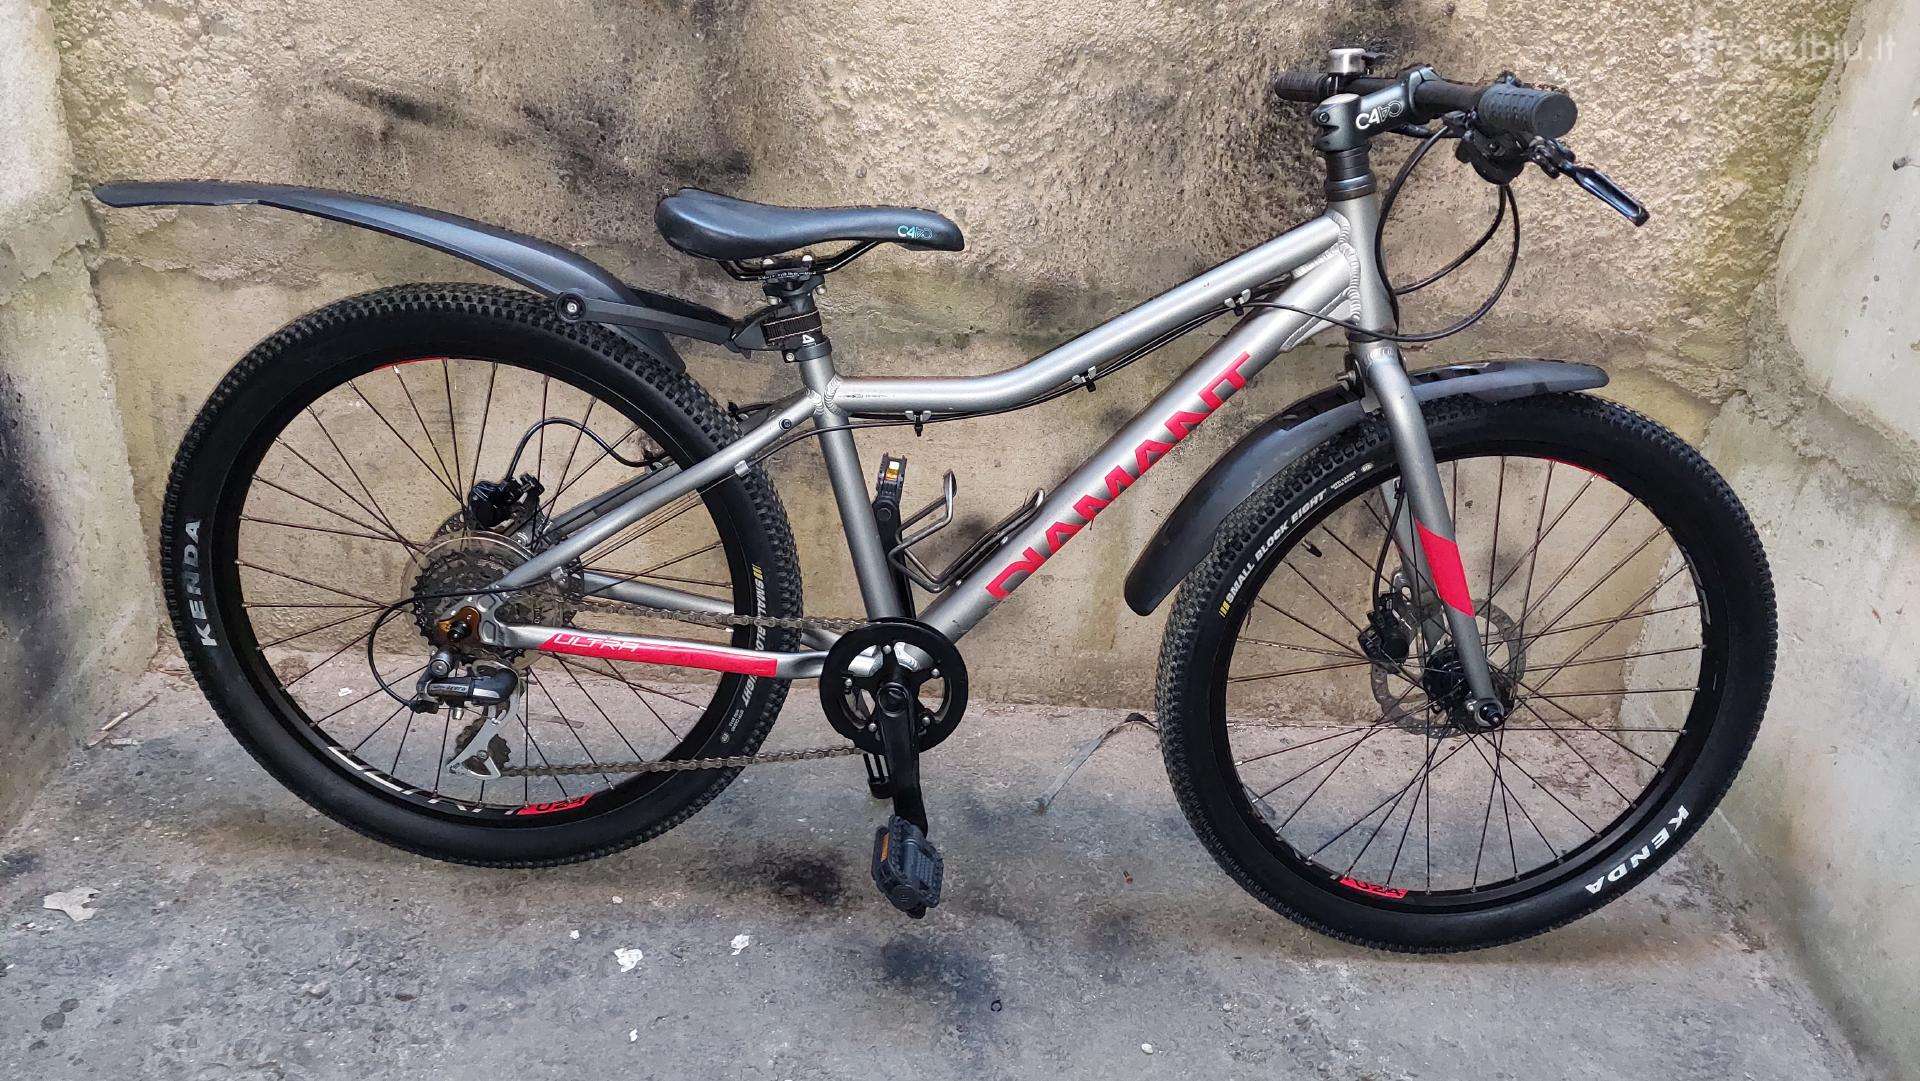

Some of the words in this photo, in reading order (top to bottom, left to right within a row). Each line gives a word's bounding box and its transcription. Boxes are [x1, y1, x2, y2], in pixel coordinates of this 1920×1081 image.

[183, 520, 218, 647] KENDA
[1226, 562, 1256, 604] SMALL
[1255, 519, 1290, 562] BLOCK
[1290, 487, 1328, 525] EIGHT
[554, 632, 640, 654] ULTRA
[754, 577, 767, 618] SMAL
[1585, 804, 1690, 896] KENDA
